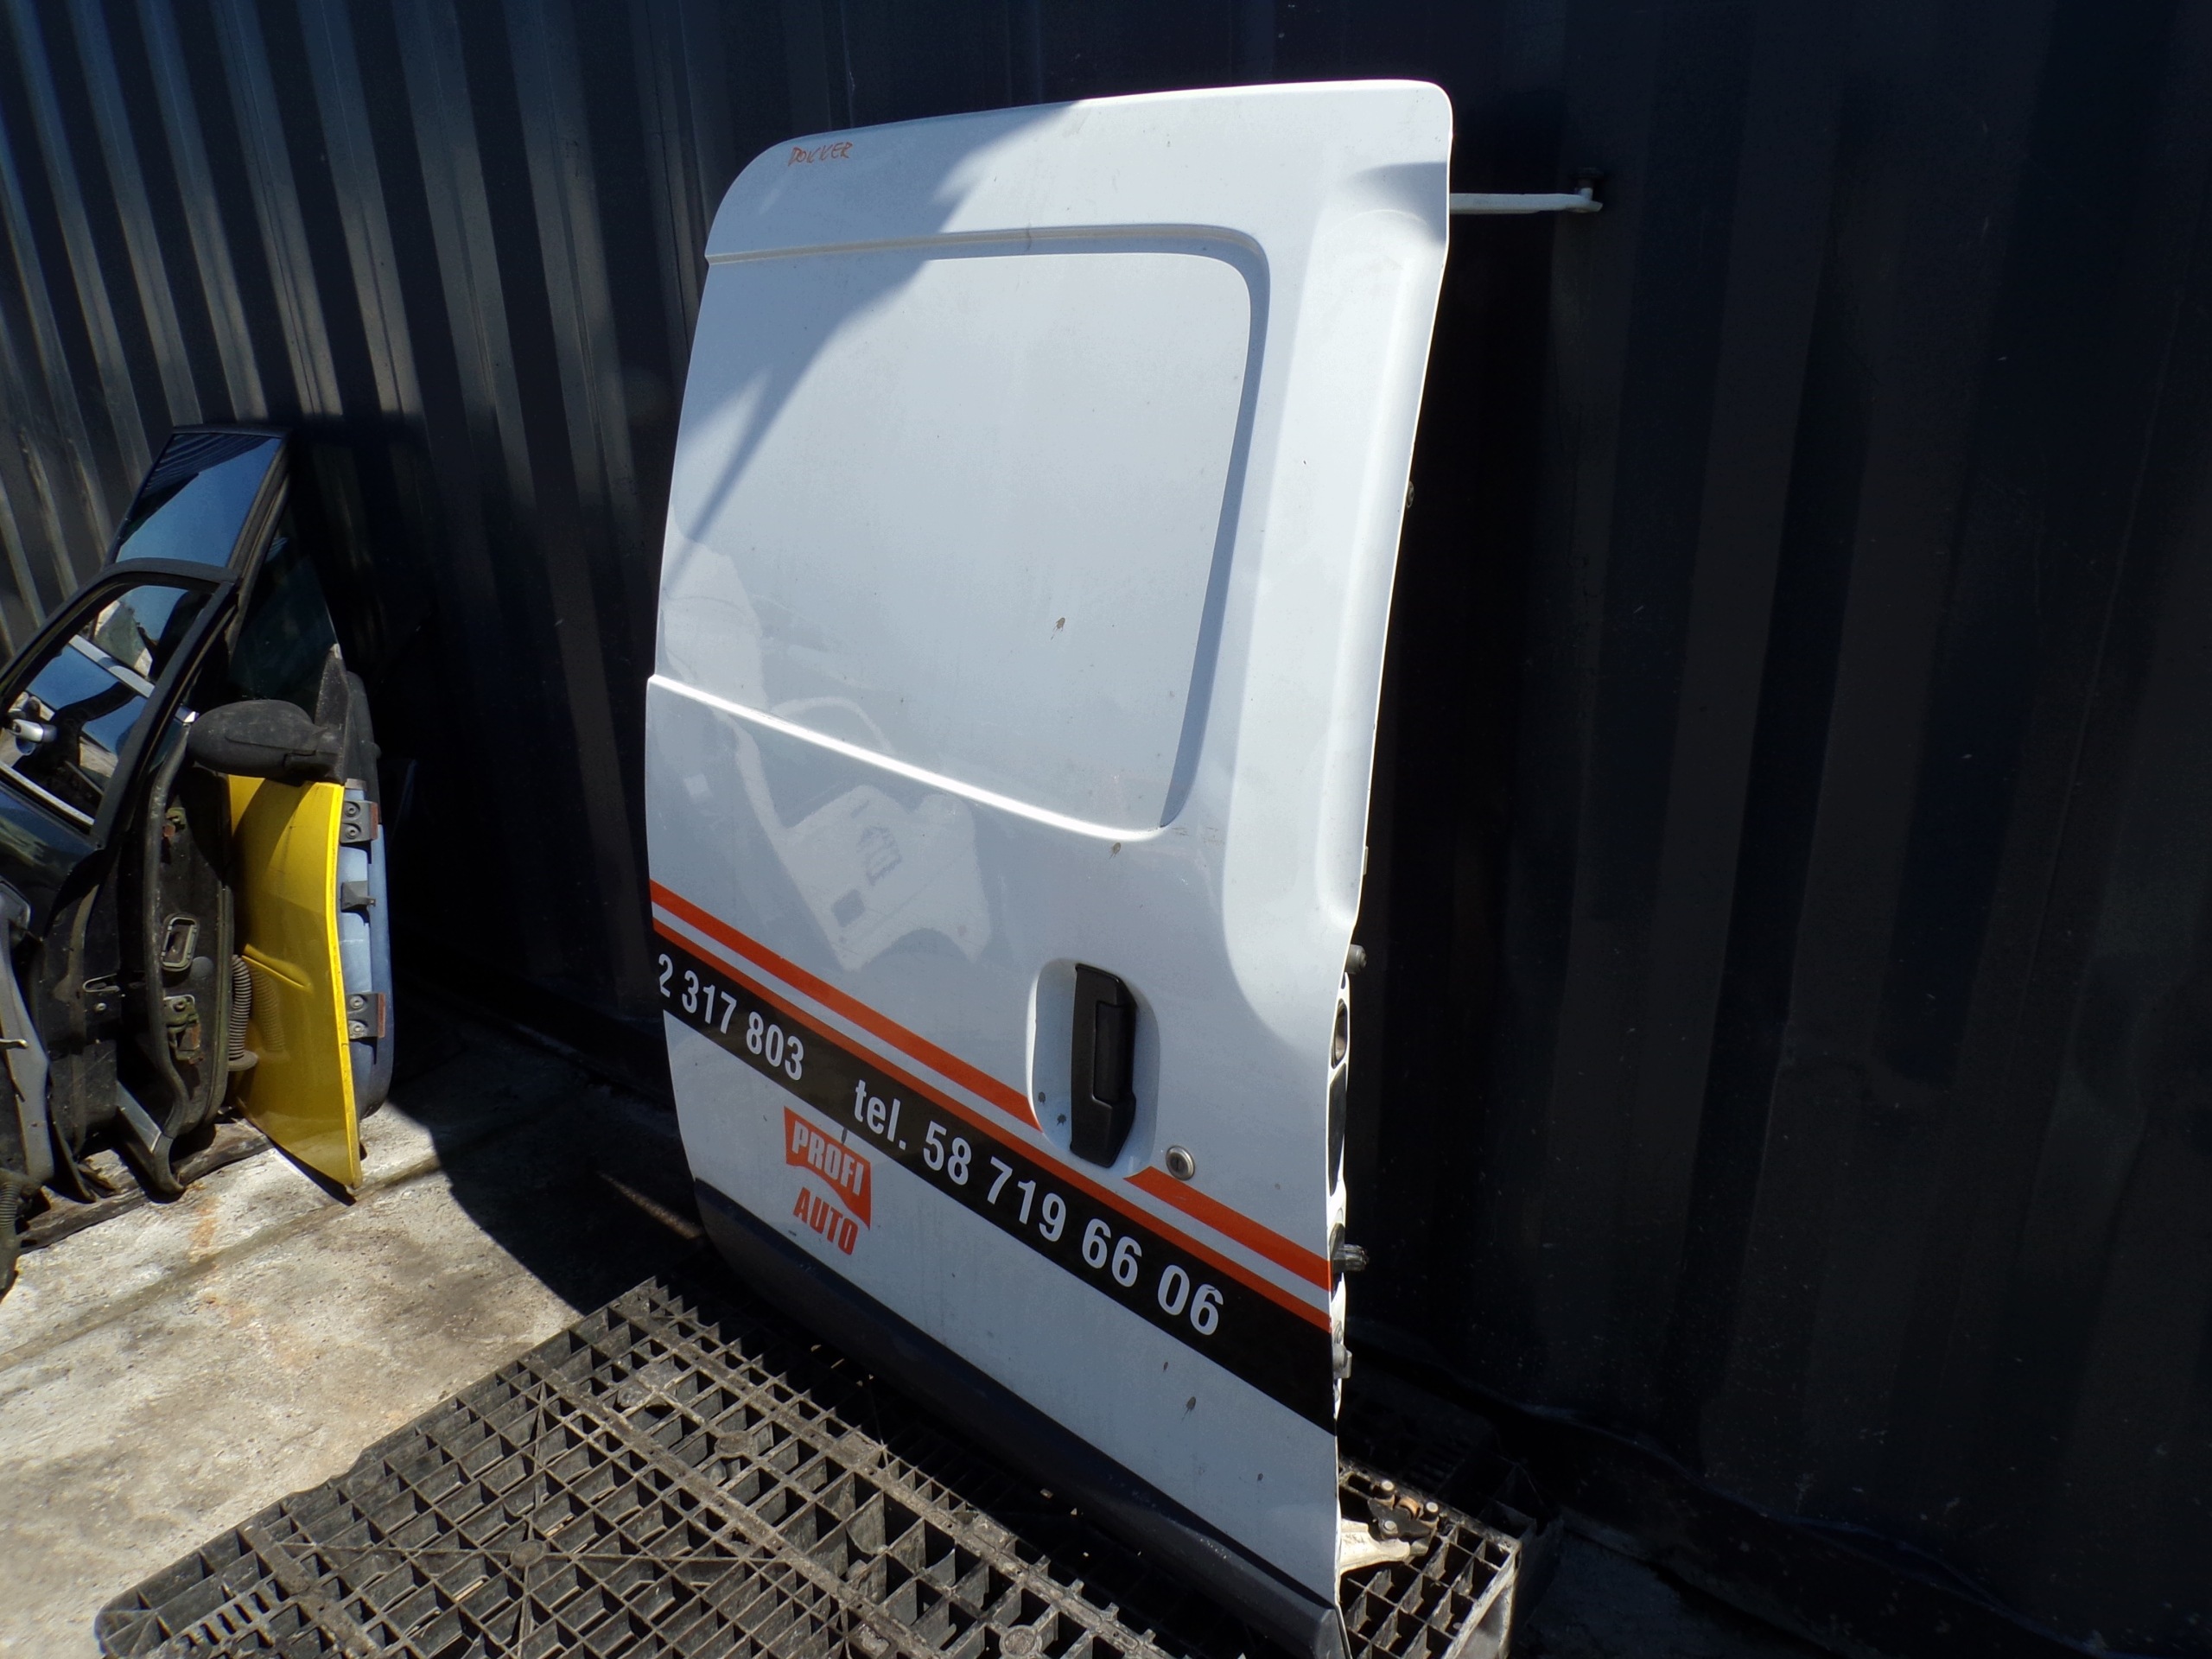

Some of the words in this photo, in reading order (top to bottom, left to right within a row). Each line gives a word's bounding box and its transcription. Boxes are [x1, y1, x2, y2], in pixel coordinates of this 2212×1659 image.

[658, 953, 673, 997] 2
[682, 969, 736, 1033] 317
[746, 1011, 804, 1080] 803
[854, 1080, 906, 1149] tel.
[924, 1121, 971, 1185] 58
[987, 1156, 1066, 1242] 719
[1081, 1218, 1142, 1287] 66
[1158, 1264, 1224, 1336] 06
[791, 1120, 865, 1197] PROFI
[793, 1186, 859, 1255] AUTO
